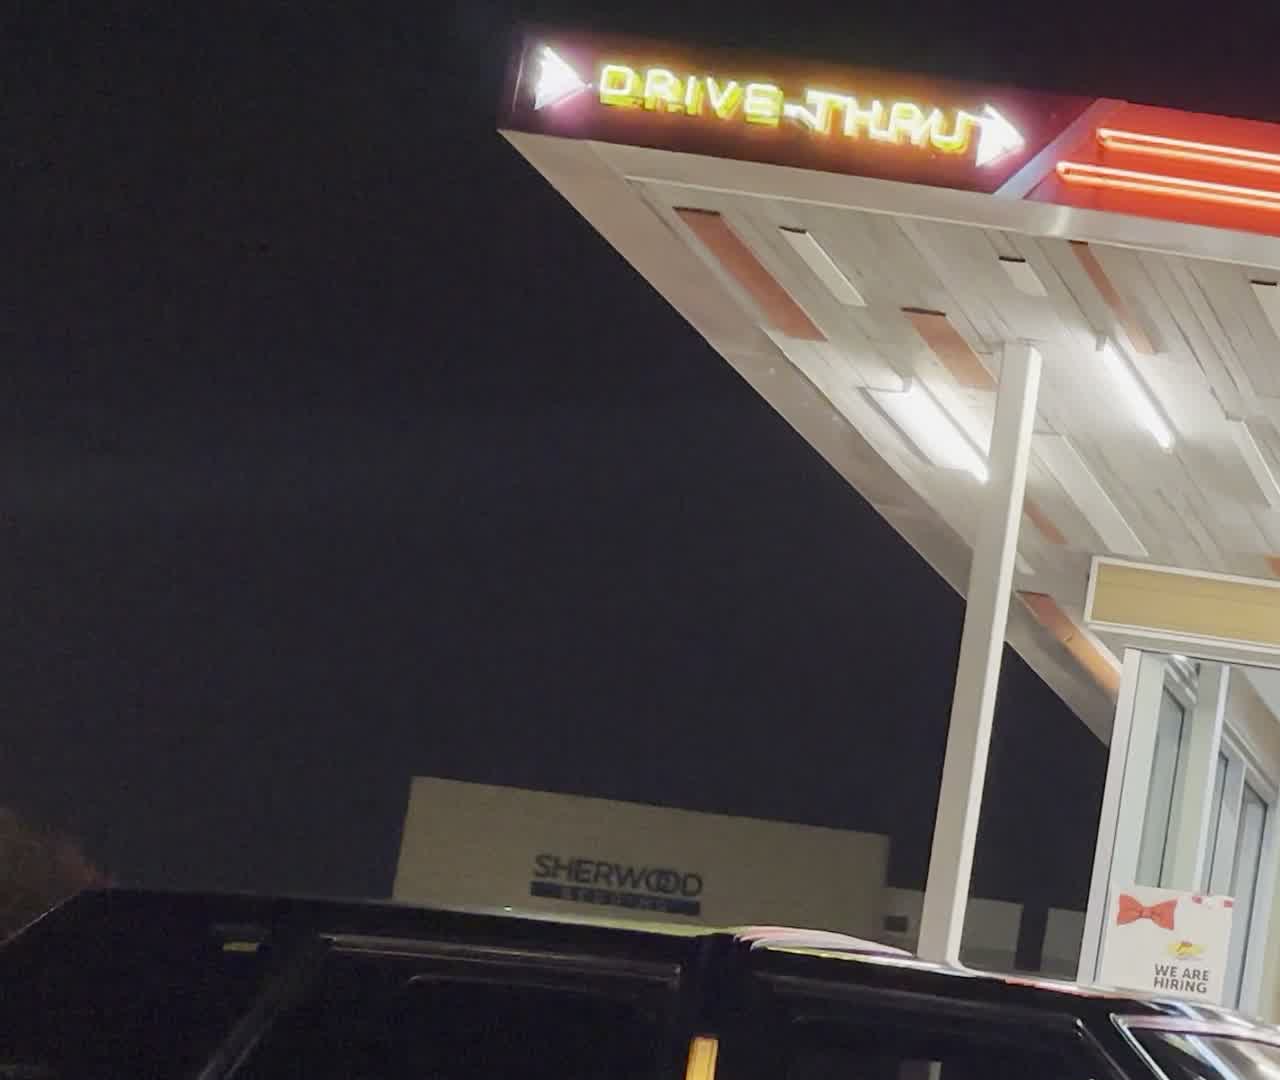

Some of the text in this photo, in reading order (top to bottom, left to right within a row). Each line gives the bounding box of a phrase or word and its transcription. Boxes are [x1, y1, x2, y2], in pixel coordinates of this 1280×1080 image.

[534, 853, 704, 897] SHERWOOD
[1154, 963, 1210, 982] WE ARE
[1153, 976, 1208, 994] HIRING
